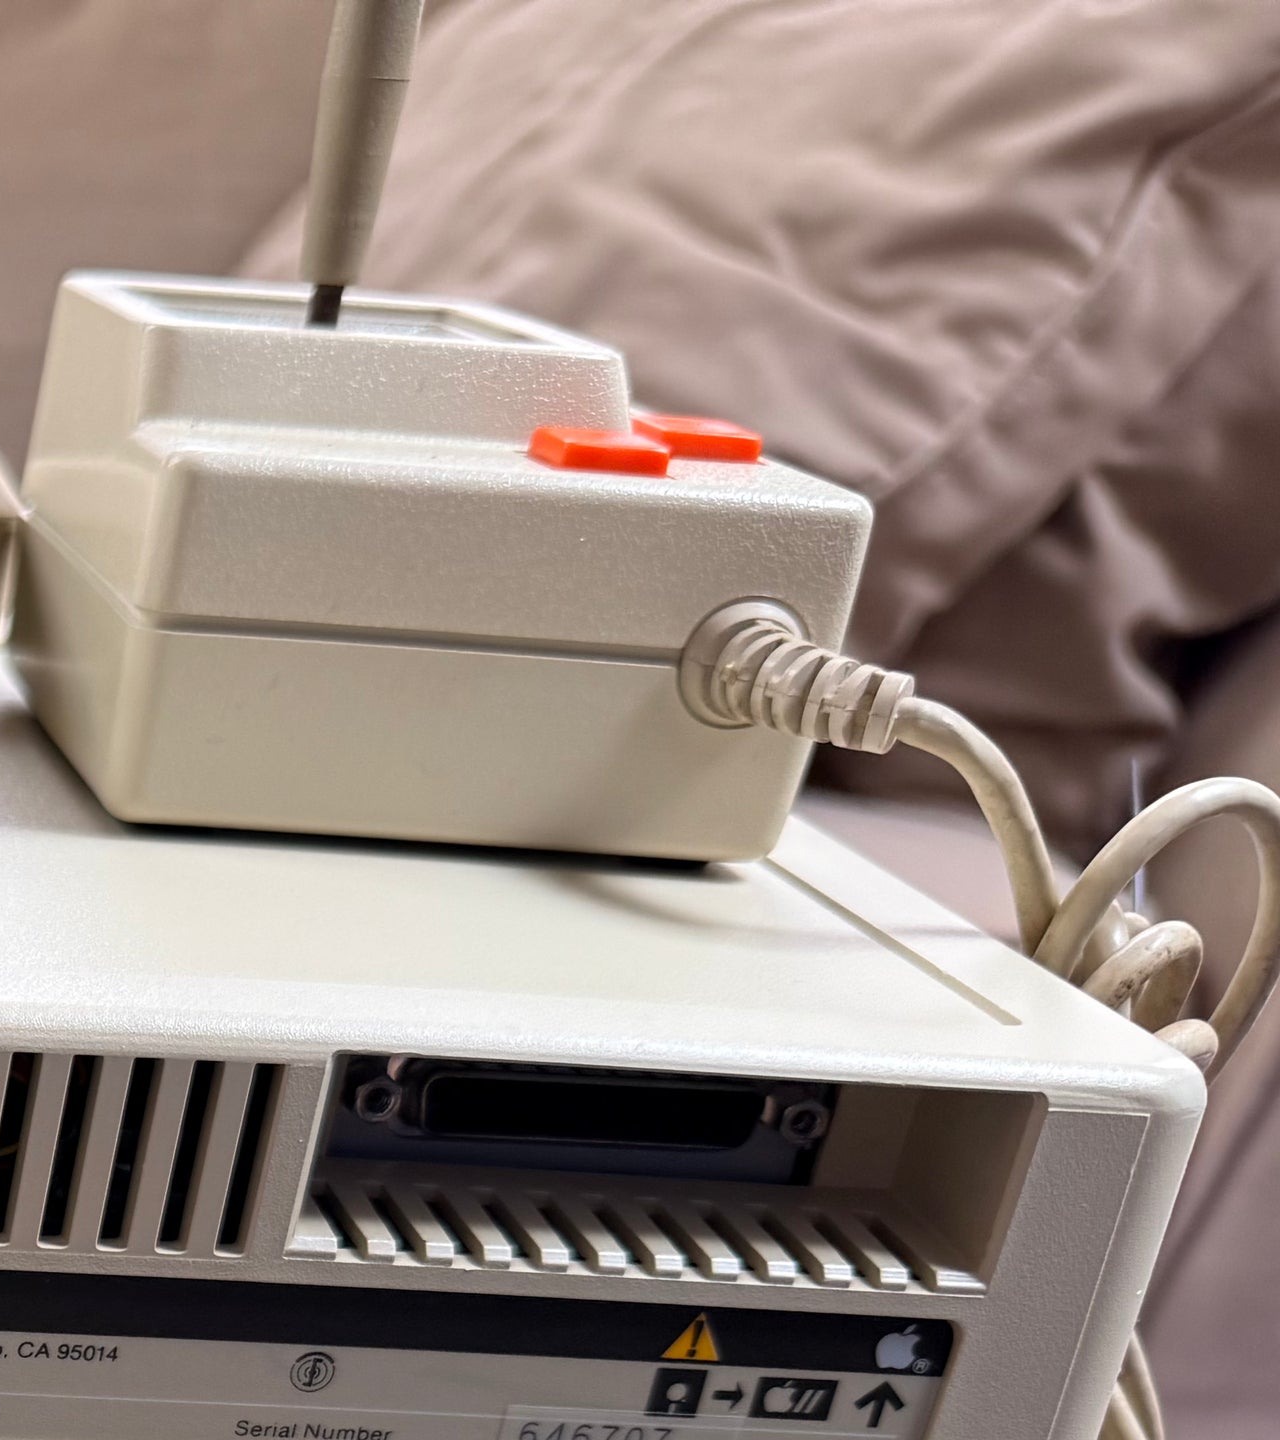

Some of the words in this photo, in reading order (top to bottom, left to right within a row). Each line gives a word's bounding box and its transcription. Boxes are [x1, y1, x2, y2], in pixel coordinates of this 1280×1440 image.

[17, 1341, 50, 1359] CA
[56, 1344, 119, 1362] 95014
[233, 1419, 297, 1439] Serial
